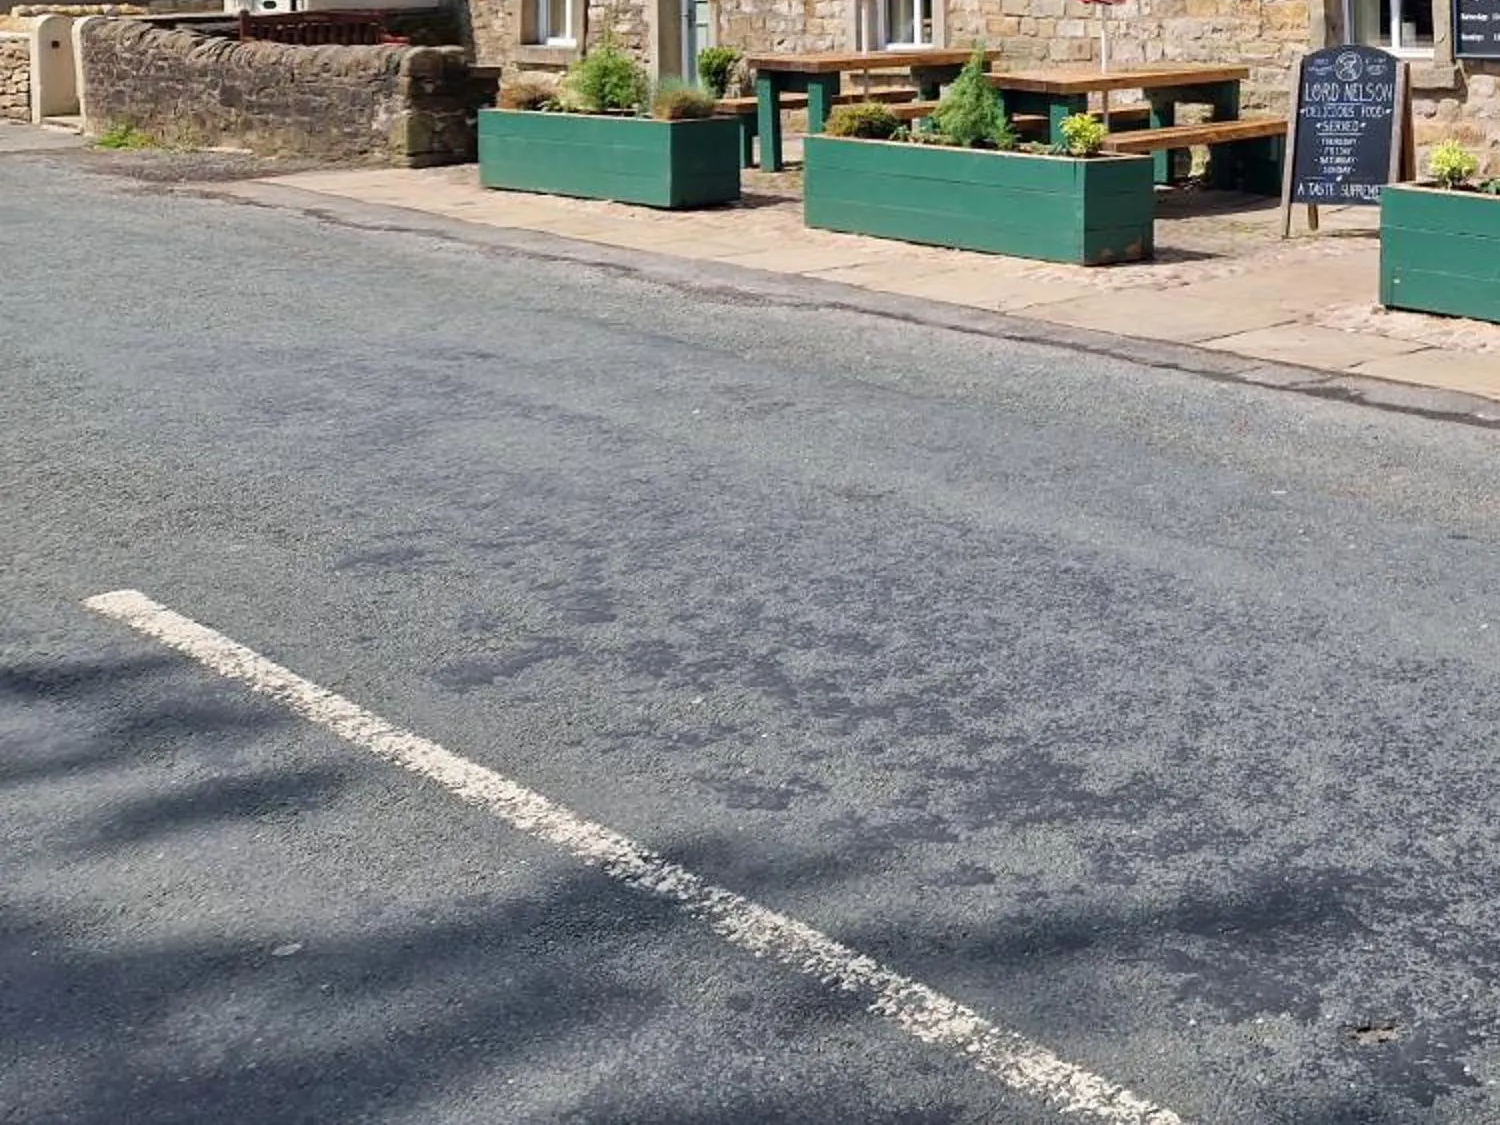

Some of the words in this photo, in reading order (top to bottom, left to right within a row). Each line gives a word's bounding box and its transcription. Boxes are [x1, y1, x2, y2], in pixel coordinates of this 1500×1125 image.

[1305, 82, 1340, 102] LORD
[1344, 82, 1393, 102] NELSON
[1305, 105, 1355, 118] DELICIOUS
[1361, 105, 1384, 118] FOOD
[1322, 120, 1359, 131] SERVED
[1297, 182, 1305, 196] A
[1308, 182, 1334, 196] TASTE
